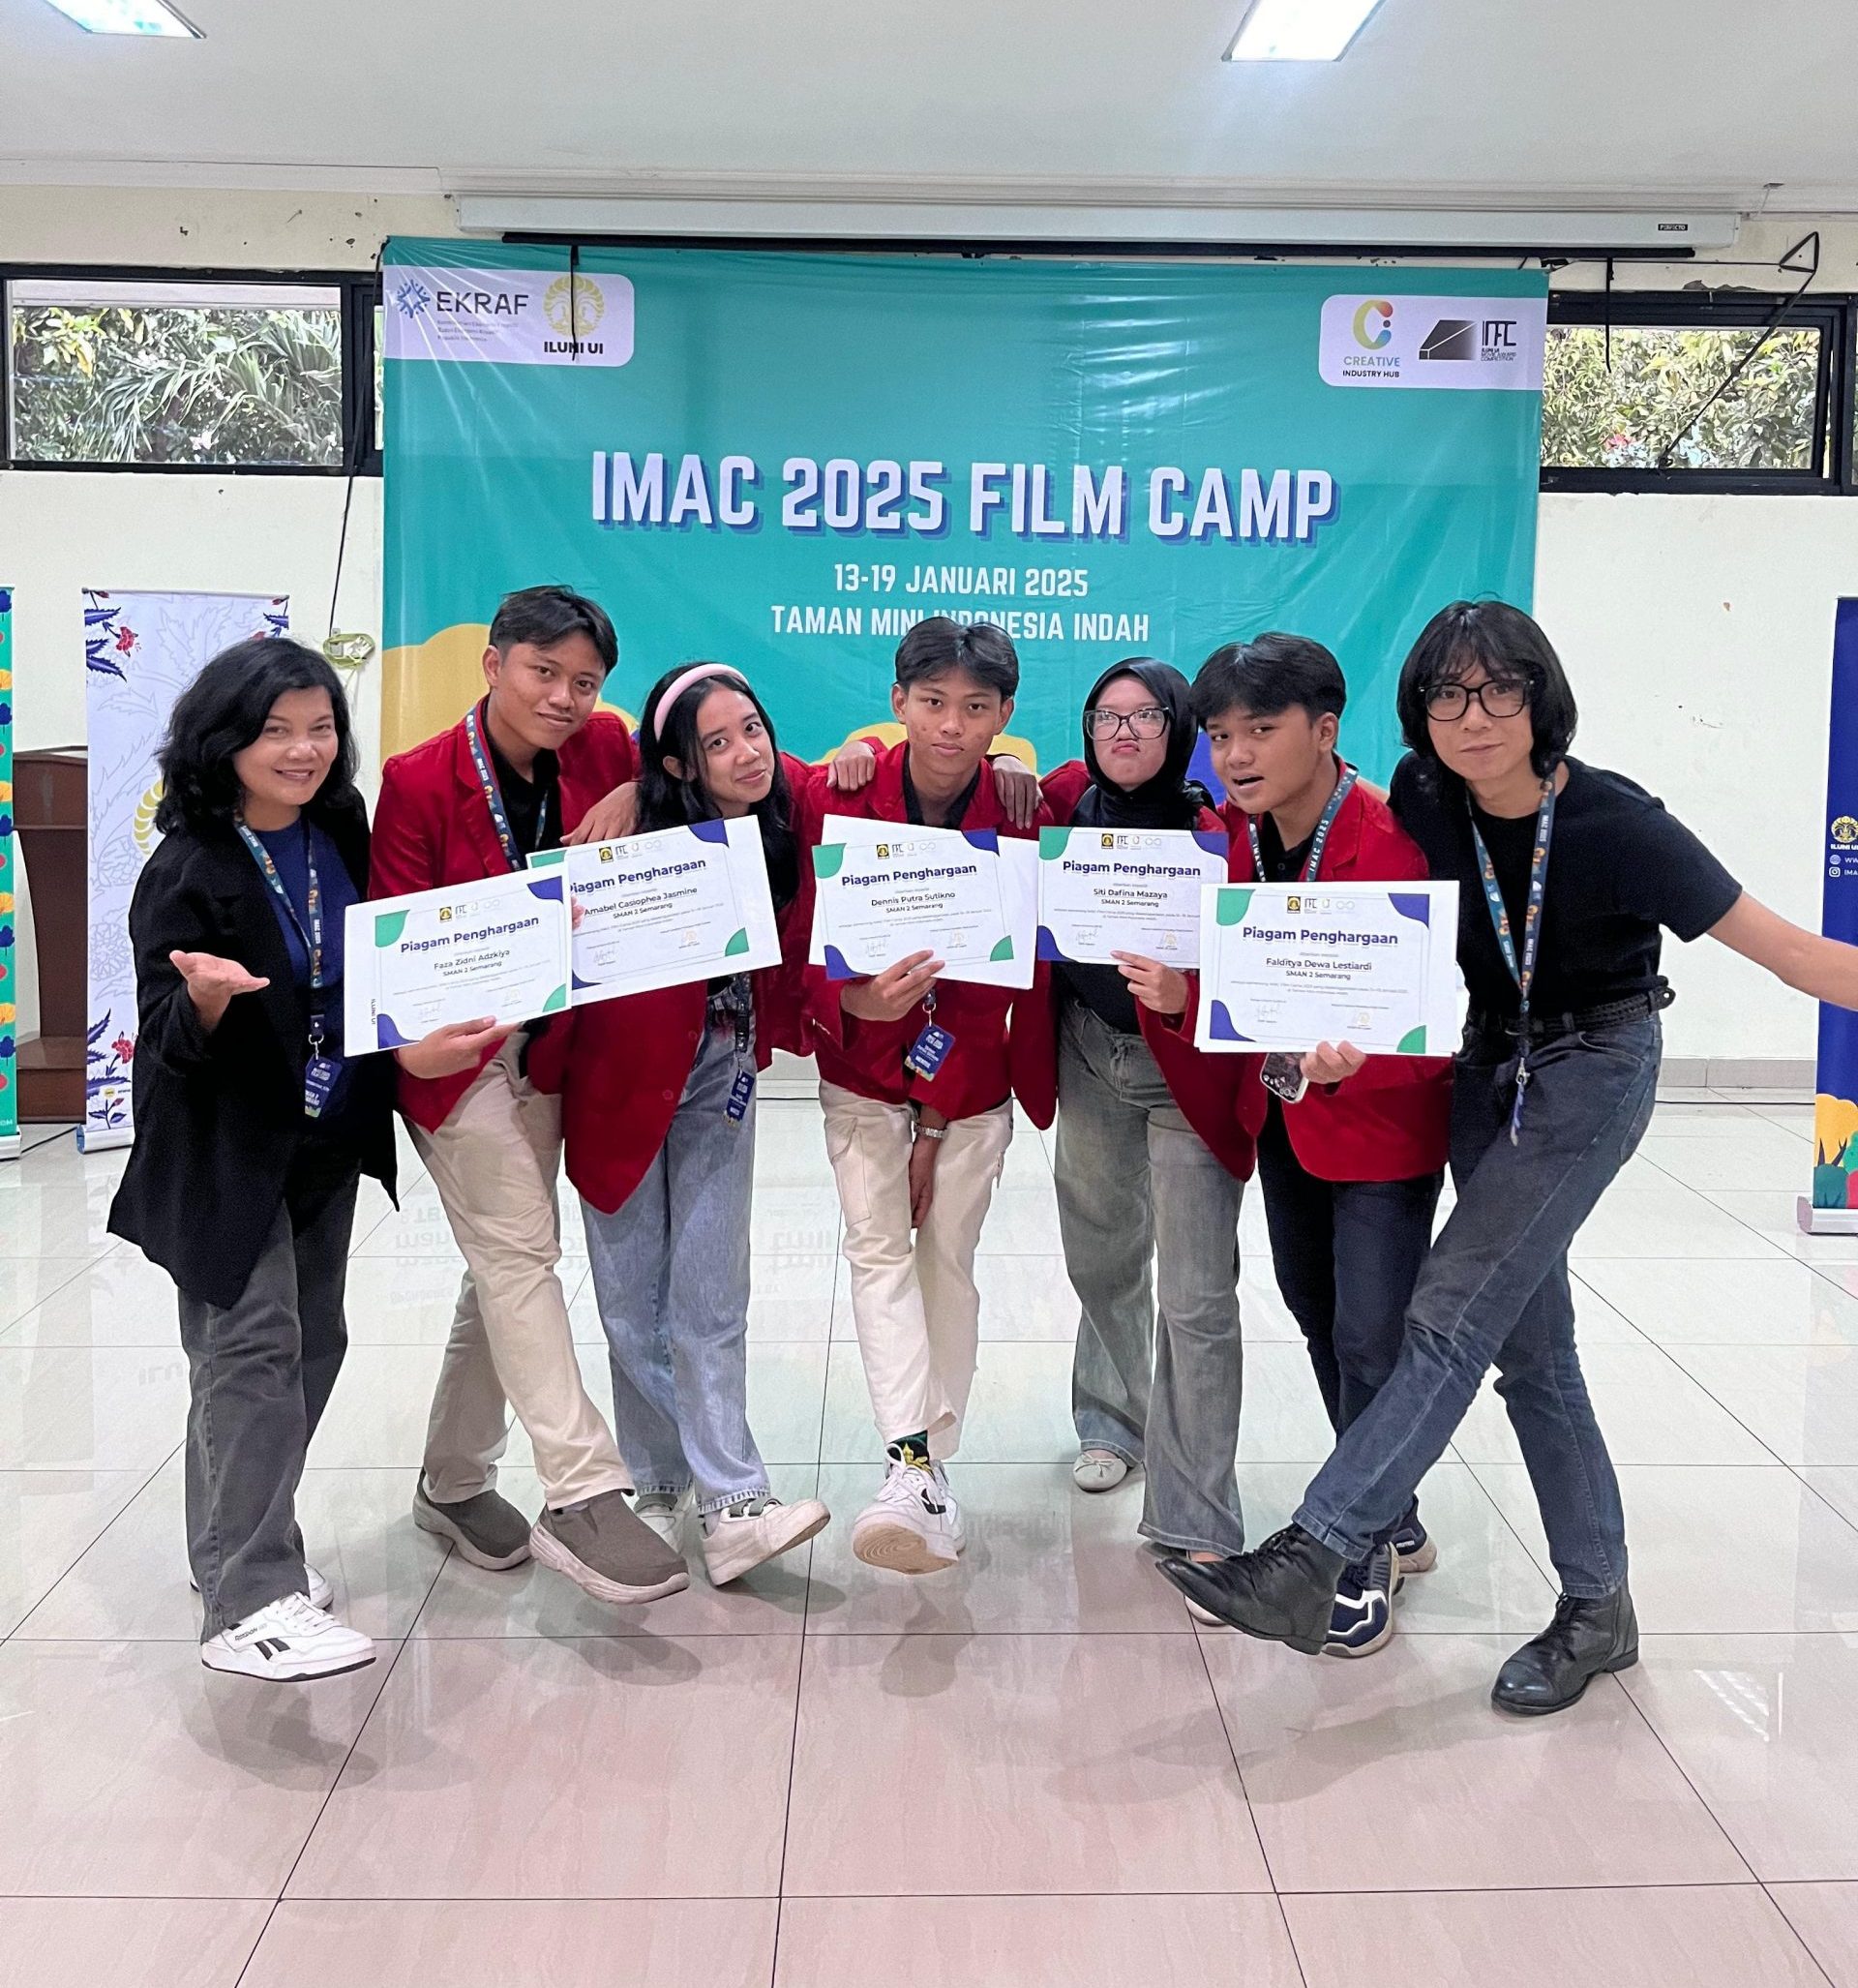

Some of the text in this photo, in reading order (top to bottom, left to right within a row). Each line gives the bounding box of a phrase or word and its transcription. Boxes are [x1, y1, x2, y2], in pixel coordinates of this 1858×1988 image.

[436, 290, 529, 316] EKRAF
[586, 342, 604, 355] UI
[1343, 356, 1400, 367] CREATIVE
[591, 450, 1337, 544] IMAC 2025 FILM CAMP
[834, 563, 1089, 597] 13-19 JANUARI 2025
[770, 604, 862, 635] TAMAN
[1073, 612, 1150, 643] INDAH
[1309, 819, 1330, 871] IMAC 2025
[618, 858, 706, 885] Penghargaan
[841, 863, 977, 888] Piagam Penghargaan
[1063, 860, 1201, 878] Piagam Penghargaan
[584, 902, 617, 917] Amabel
[619, 894, 662, 911] Casiophea
[663, 887, 698, 900] Jasmine
[871, 896, 899, 907] Dennis
[901, 894, 923, 904] Putra
[924, 890, 956, 901] Sutikno
[1093, 888, 1168, 900] Siti Dafina Mazaya
[639, 902, 674, 915] Semarang
[911, 901, 944, 912] Semarang
[1126, 899, 1159, 908] Semarang
[401, 936, 450, 953] Piagam
[453, 917, 539, 943] Penghargaan
[1243, 926, 1399, 947] Piagam Penghargaan
[434, 958, 454, 970] Faza
[469, 961, 503, 973] Semarang
[1266, 957, 1373, 971] Falditya Dewa Lestiardi
[1285, 970, 1308, 979] SMAN
[1314, 971, 1352, 980] Semarang
